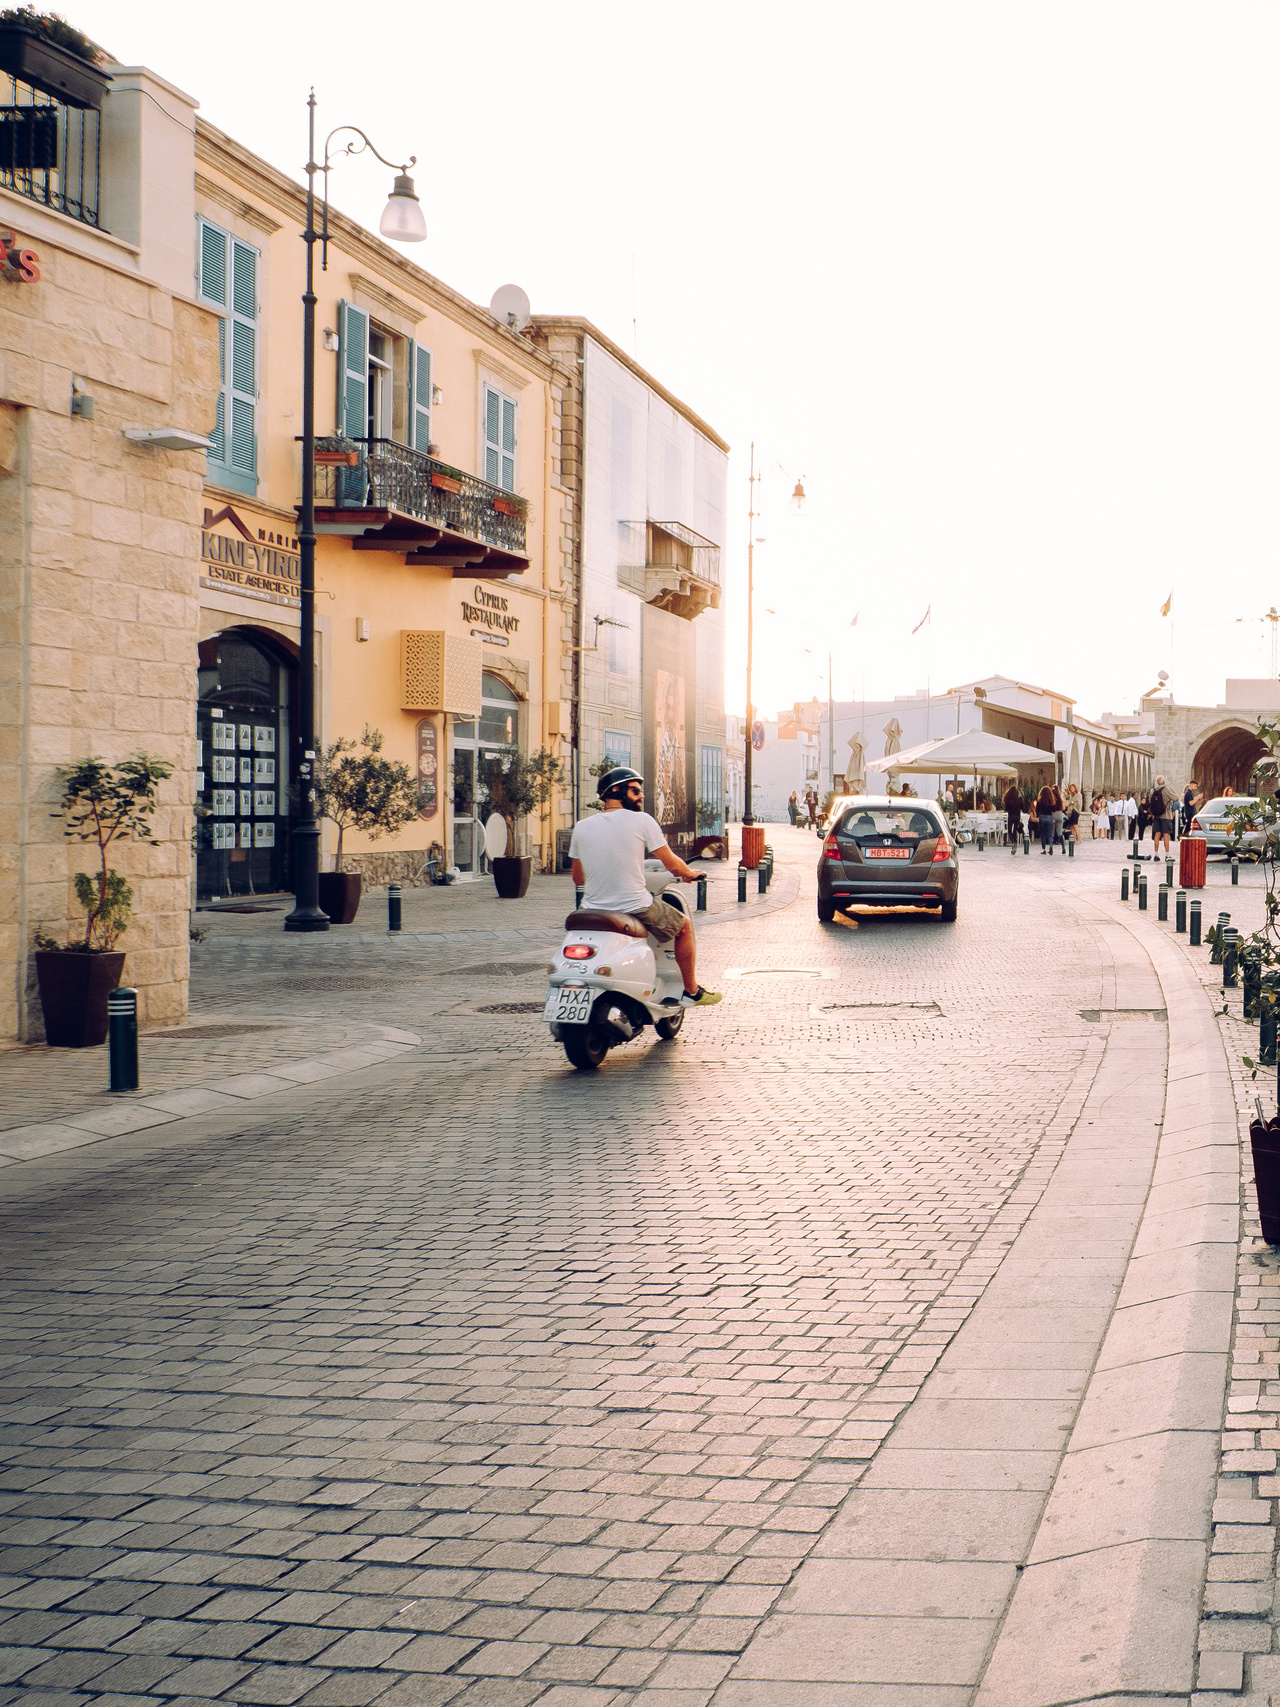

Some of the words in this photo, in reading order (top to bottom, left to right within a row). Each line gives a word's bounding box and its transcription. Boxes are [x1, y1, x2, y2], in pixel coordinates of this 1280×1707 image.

[0, 230, 41, 284] 's
[208, 565, 243, 584] ESTATE
[244, 574, 289, 595] AGENCIES
[461, 601, 520, 634] RESTAURANT
[890, 849, 906, 857] 521
[559, 989, 590, 1005] HXA
[556, 1005, 588, 1020] 280
